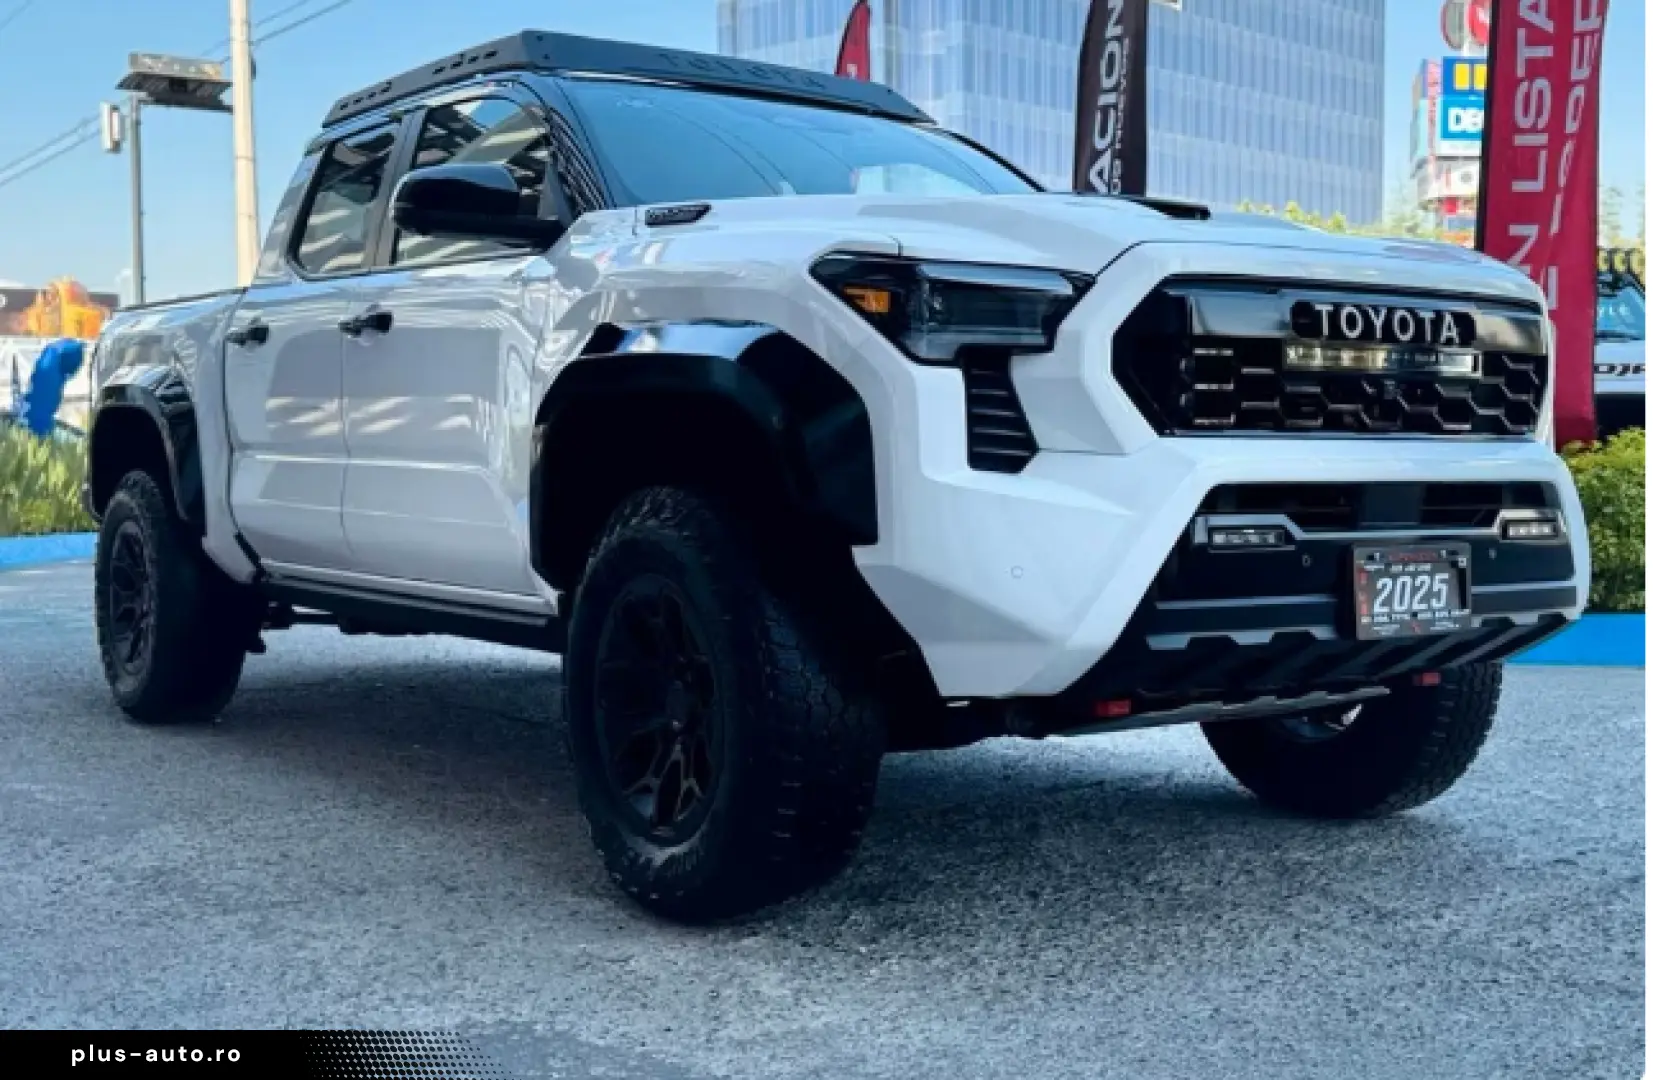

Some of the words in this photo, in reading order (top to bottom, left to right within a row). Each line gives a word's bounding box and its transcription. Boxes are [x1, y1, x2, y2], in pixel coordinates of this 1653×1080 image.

[1089, 0, 1124, 194] ACION
[1511, 0, 1554, 192] LISTA
[1314, 303, 1460, 344] TOYOTA
[1373, 572, 1450, 613] 2025
